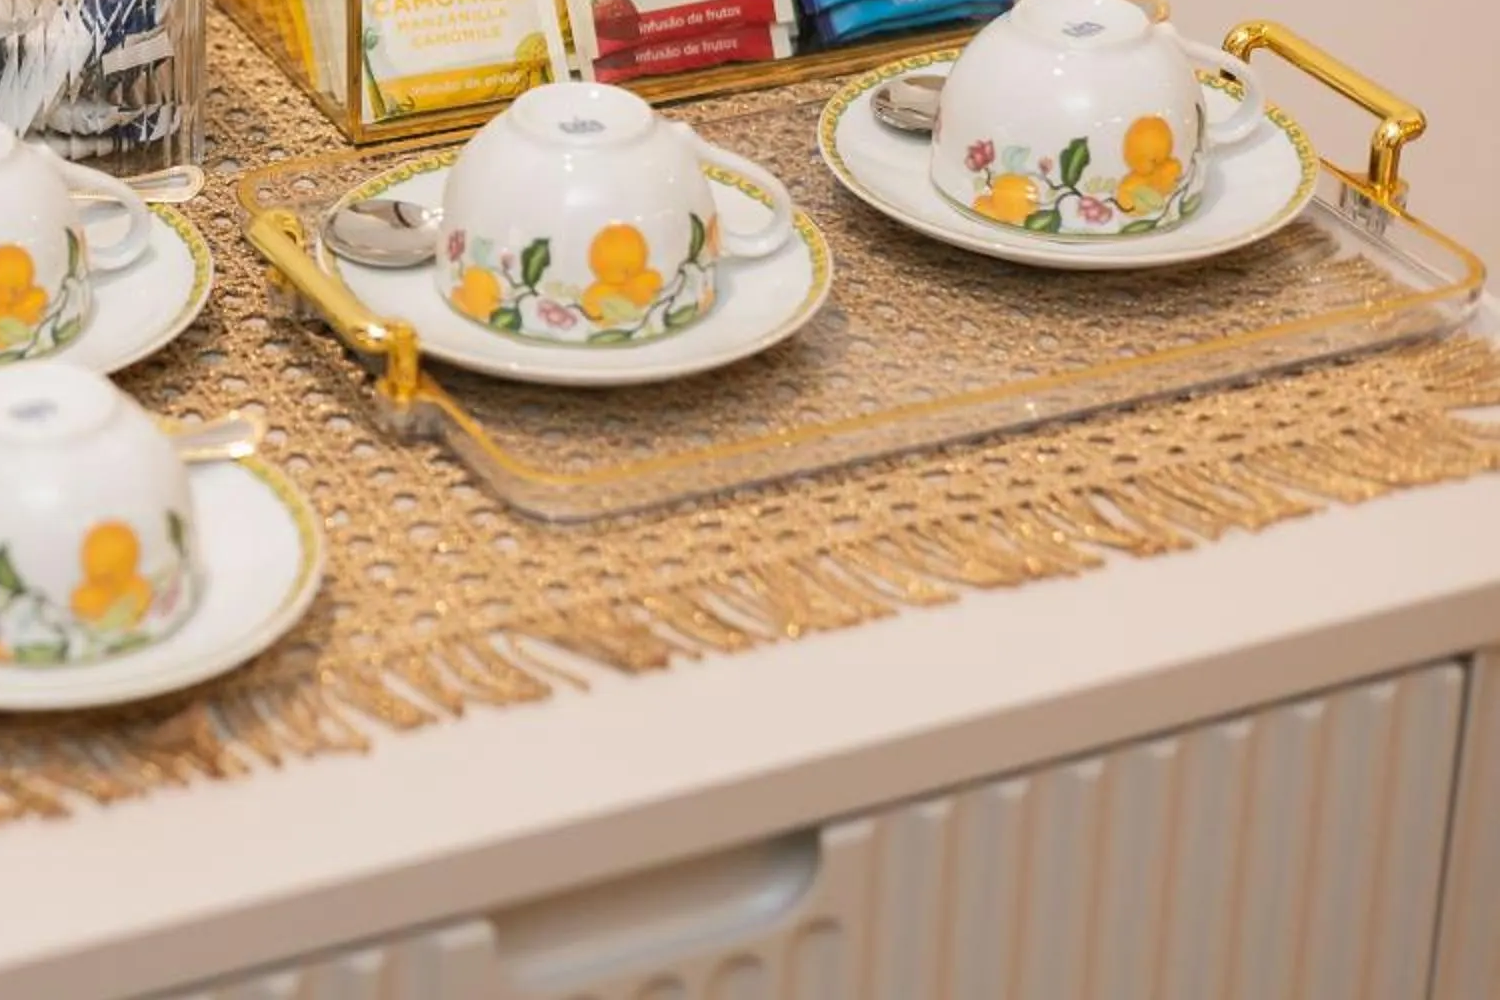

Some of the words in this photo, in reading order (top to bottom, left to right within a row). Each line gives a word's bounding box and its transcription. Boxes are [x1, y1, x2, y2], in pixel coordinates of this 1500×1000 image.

[639, 17, 684, 34] infusão
[688, 12, 703, 25] de
[706, 5, 741, 22] frutos
[684, 43, 699, 56] de
